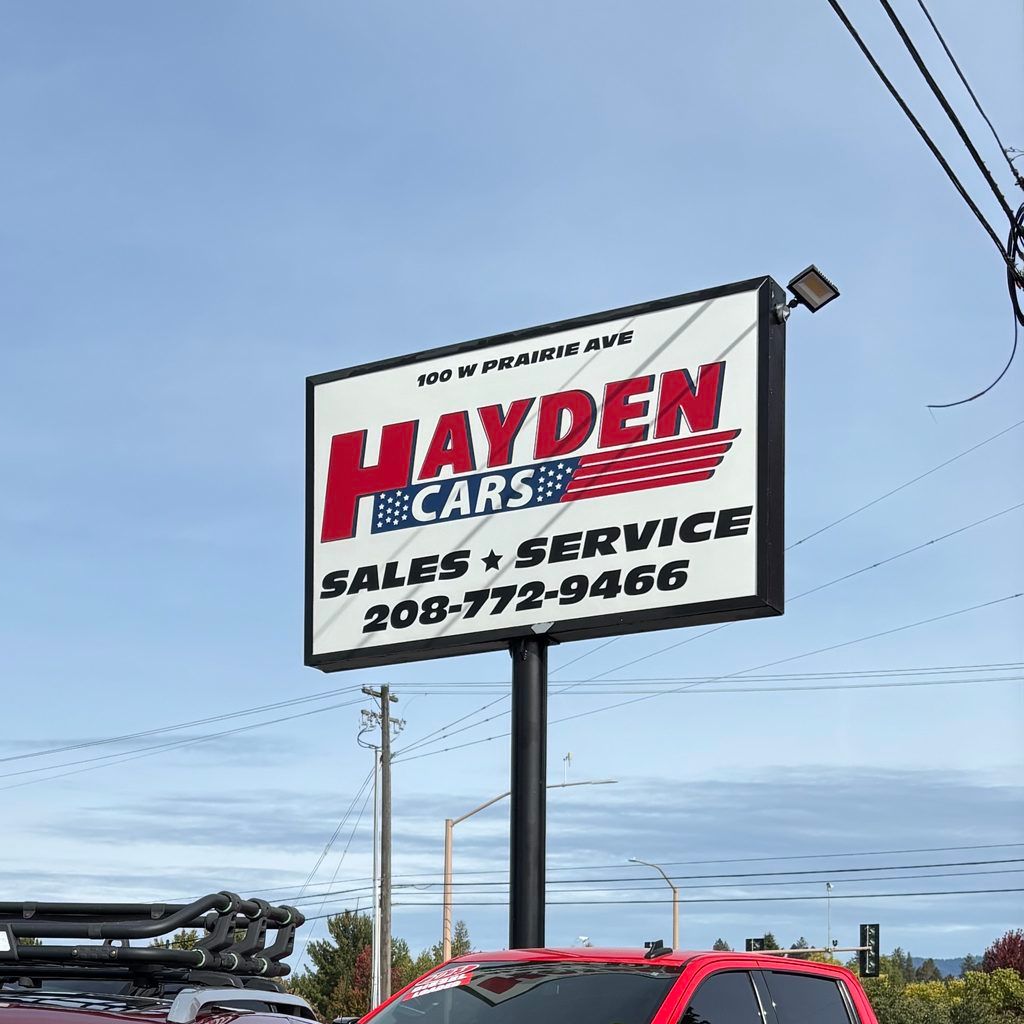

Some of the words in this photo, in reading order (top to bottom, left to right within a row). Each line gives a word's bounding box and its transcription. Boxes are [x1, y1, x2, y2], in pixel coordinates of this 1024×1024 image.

[417, 369, 453, 387] 100
[458, 363, 478, 379] W
[481, 341, 581, 374] PRAIRIE
[583, 330, 634, 353] AVE
[321, 360, 727, 543] HAYDEN
[410, 468, 535, 522] CARS
[320, 549, 471, 599] SALES
[514, 505, 754, 568] SERVICE
[362, 559, 690, 634] 208-772-9466
